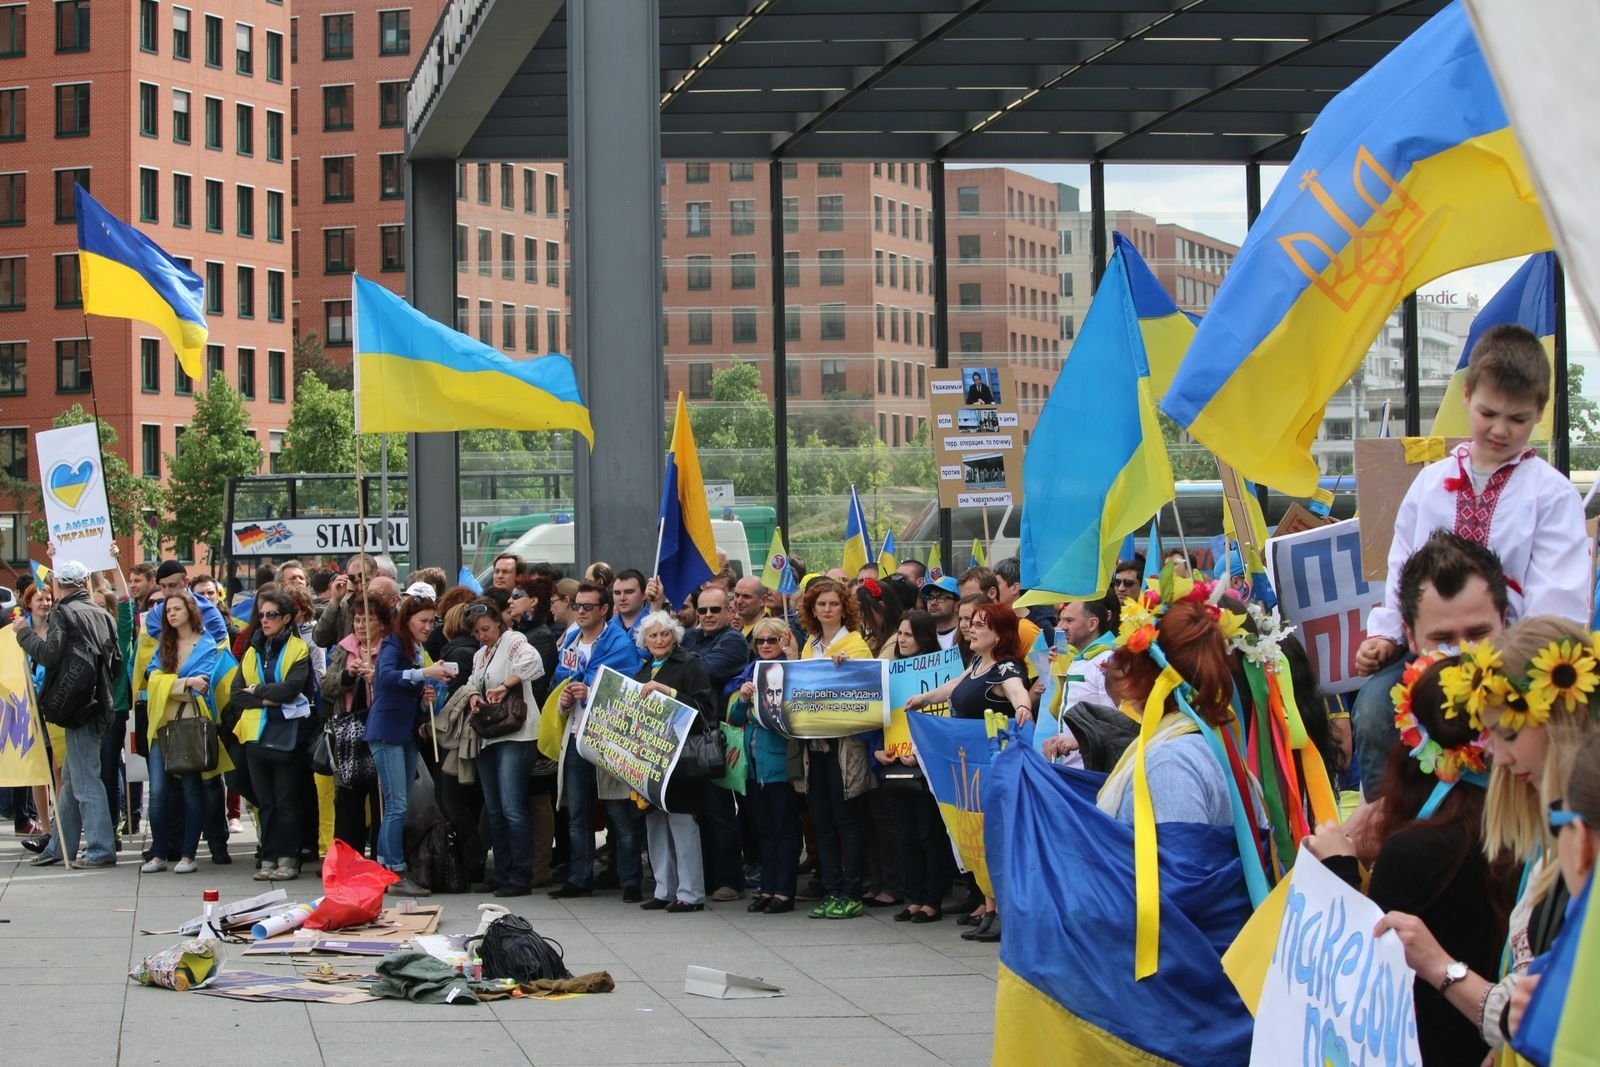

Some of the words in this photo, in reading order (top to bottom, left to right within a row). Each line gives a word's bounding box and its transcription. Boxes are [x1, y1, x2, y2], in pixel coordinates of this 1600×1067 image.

[814, 689, 838, 700] рвіть
[828, 703, 839, 711] не
[612, 700, 665, 733] ПЕРЕНОСИТЬ
[630, 724, 636, 735] В
[585, 735, 618, 759] РОССИЮ
[640, 747, 662, 765] СЕБЯ
[661, 758, 669, 768] В
